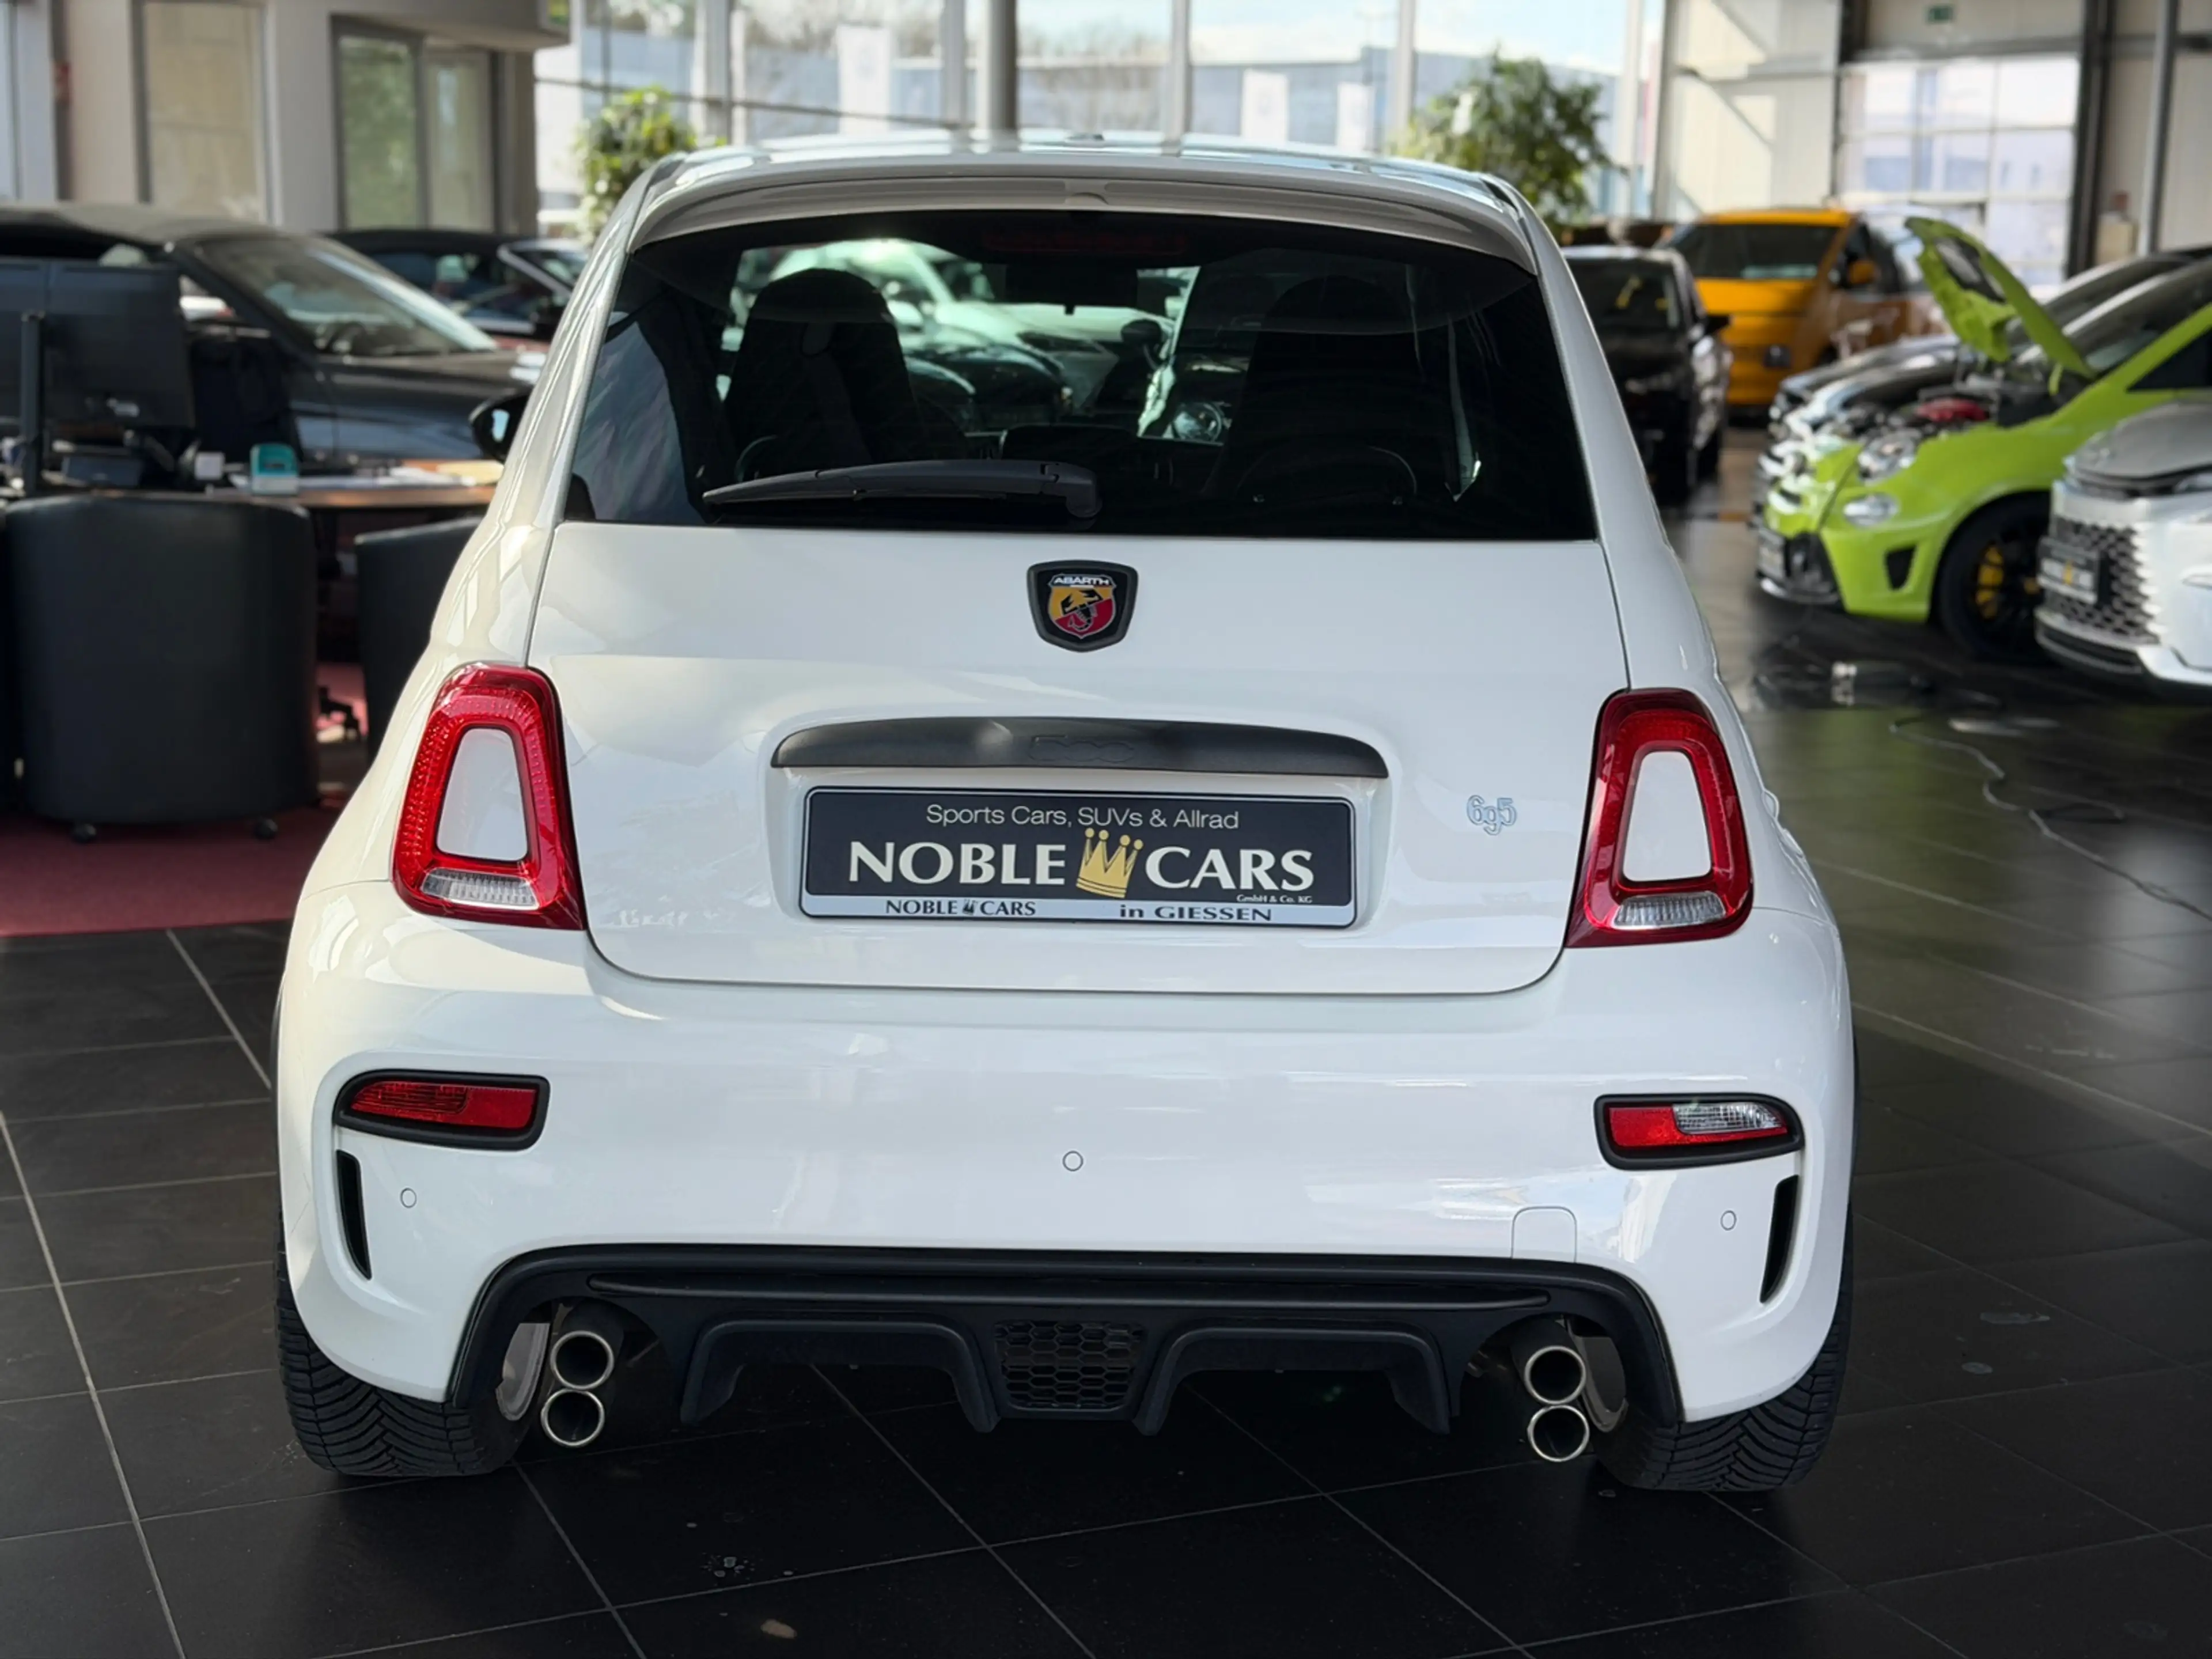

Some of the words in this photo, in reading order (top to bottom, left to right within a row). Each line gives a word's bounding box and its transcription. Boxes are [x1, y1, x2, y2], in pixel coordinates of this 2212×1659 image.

[1054, 576, 1109, 586] ABARTH
[926, 804, 1005, 827] Sports
[1011, 805, 1071, 827] Cars,
[1078, 807, 1143, 827] SUVs
[1149, 809, 1168, 828] &
[1173, 809, 1239, 829] Allrad
[849, 841, 1066, 885] NOBLE
[1145, 846, 1315, 891] CARS
[1236, 894, 1268, 903] GmbH
[1279, 895, 1295, 903] Co.
[886, 900, 957, 915] NOBLE
[979, 902, 1036, 916] CARS
[1120, 904, 1144, 918] in
[1154, 906, 1272, 922] GIESSEN
